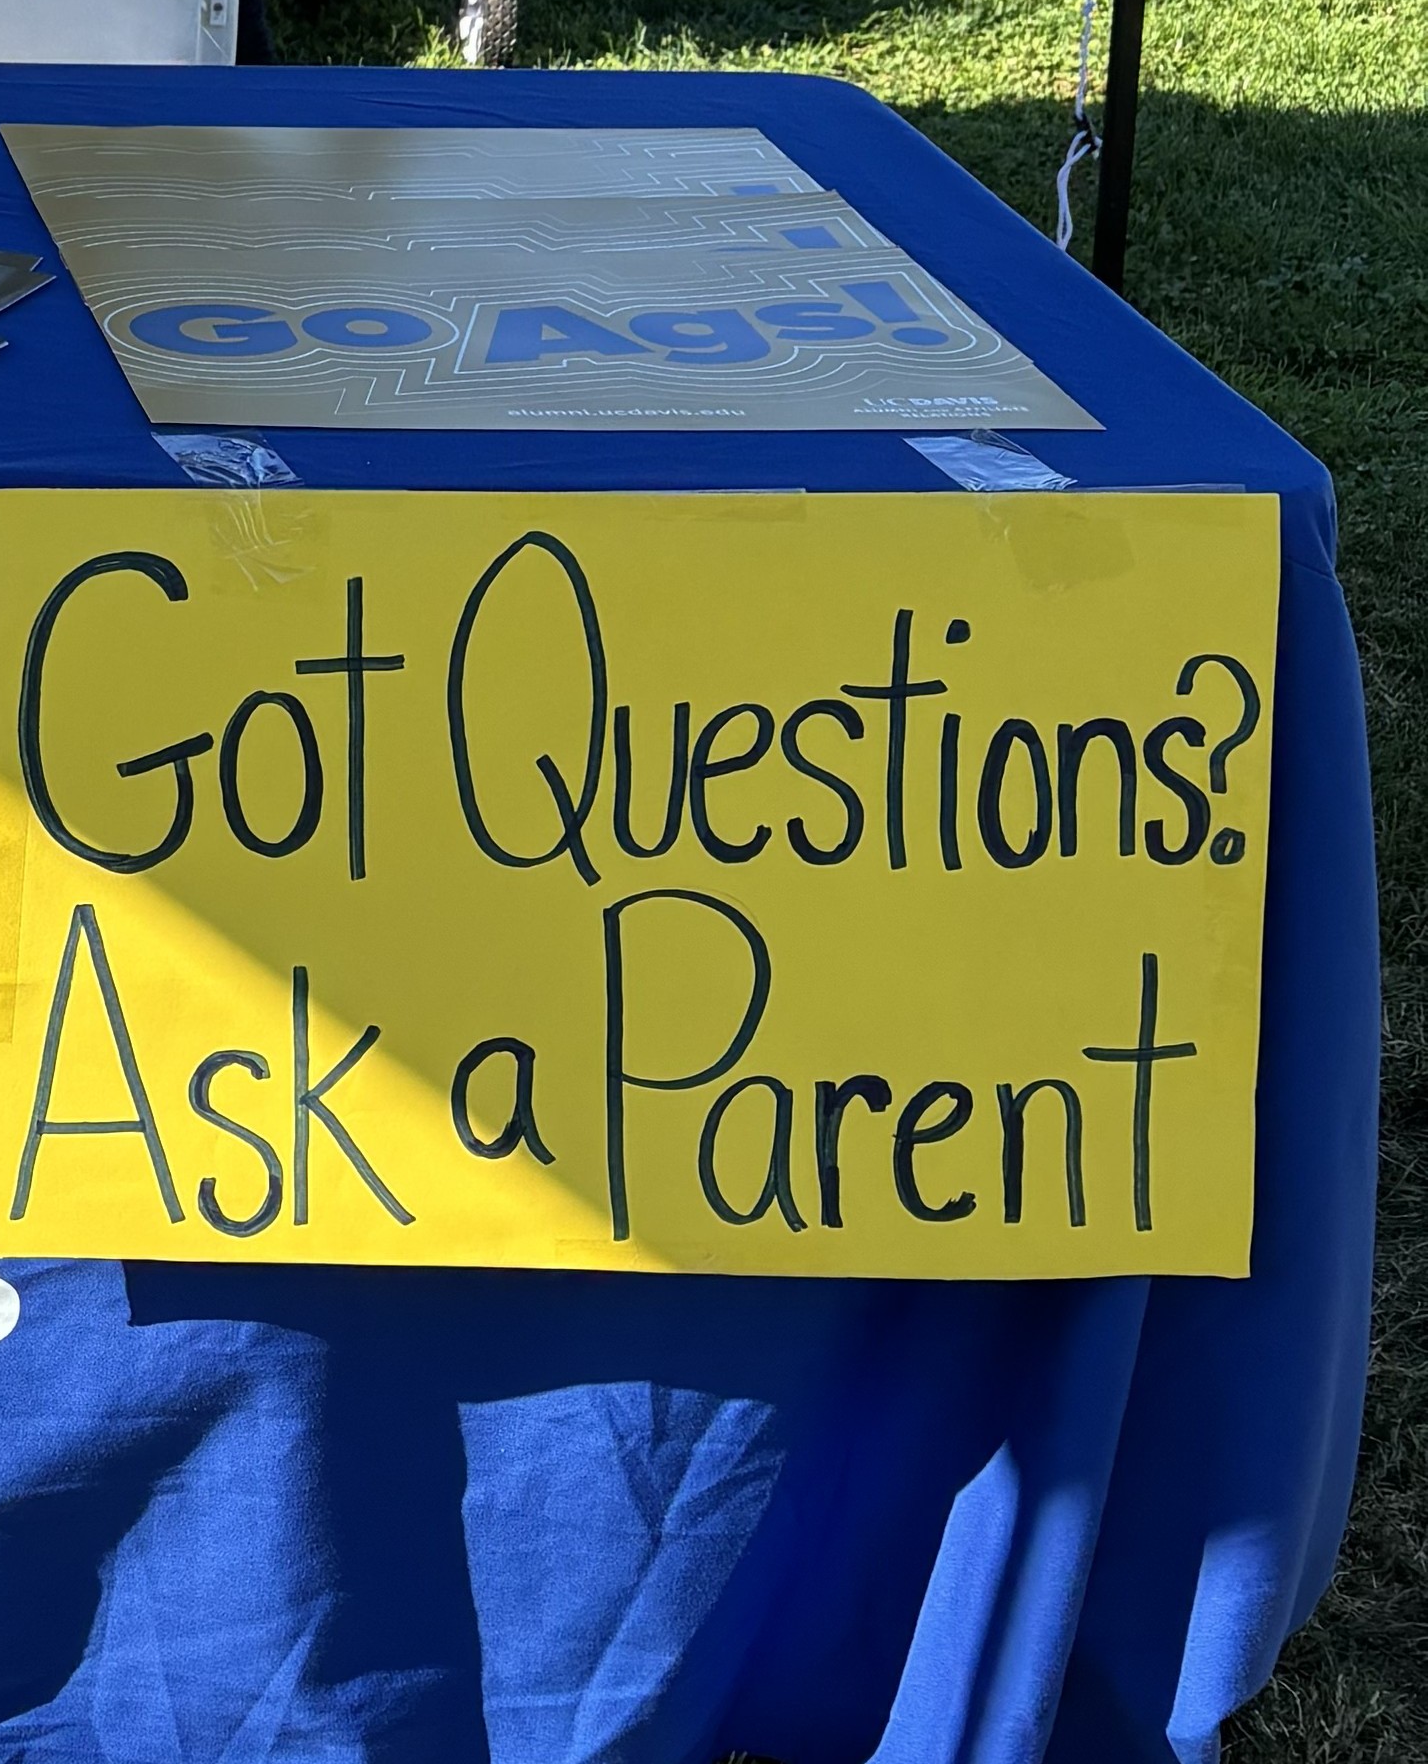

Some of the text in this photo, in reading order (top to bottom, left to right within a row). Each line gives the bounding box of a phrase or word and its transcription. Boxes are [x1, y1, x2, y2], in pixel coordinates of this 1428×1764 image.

[128, 280, 951, 366] Go Ags!
[507, 407, 747, 417] alumni.ucdavis.edu
[17, 530, 1262, 886] Got Questions?
[9, 888, 1199, 1242] Ask a Parent
